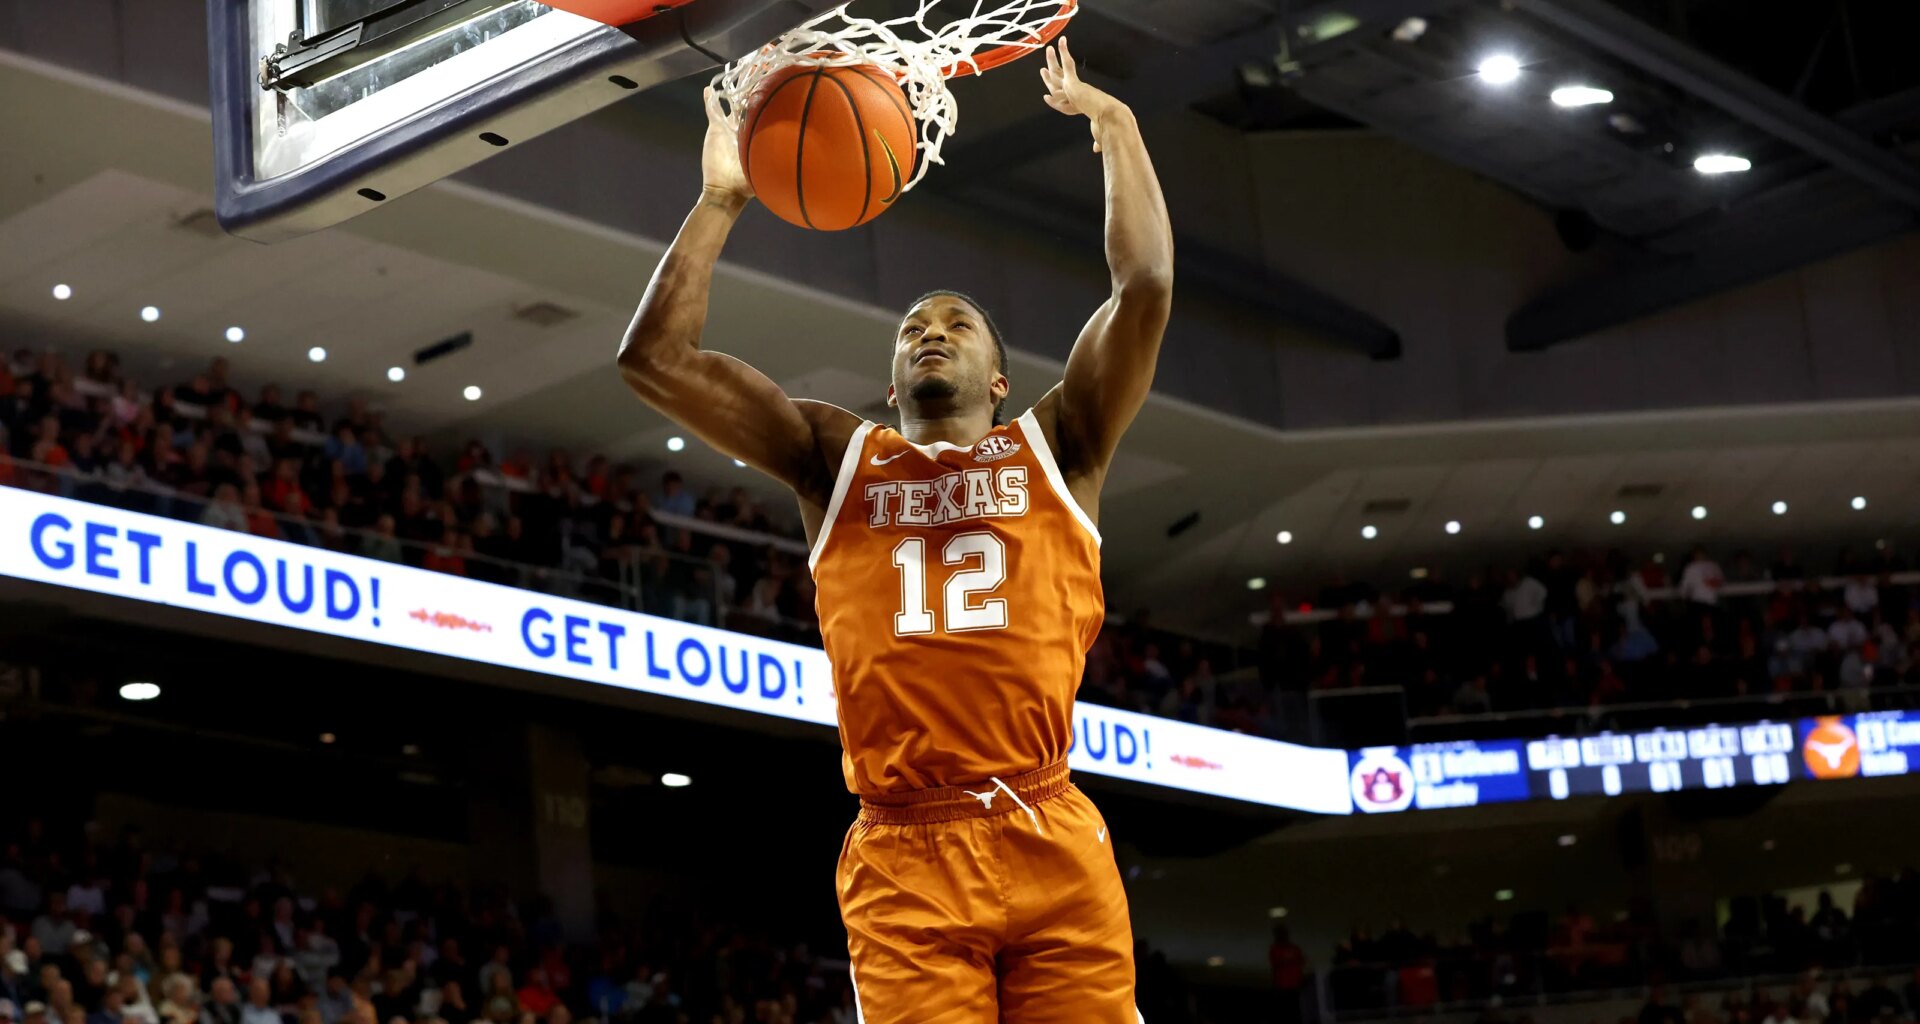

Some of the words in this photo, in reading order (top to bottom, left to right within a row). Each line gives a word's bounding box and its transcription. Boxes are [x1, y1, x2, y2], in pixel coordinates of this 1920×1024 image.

[978, 437, 1011, 455] SEC
[864, 466, 1029, 528] TEXAS
[30, 512, 162, 585] GET
[185, 541, 381, 628] LOUD!
[892, 531, 1008, 636] 12
[520, 607, 626, 671] GET
[645, 630, 804, 706] LOUD!
[1068, 717, 1152, 770] UD!
